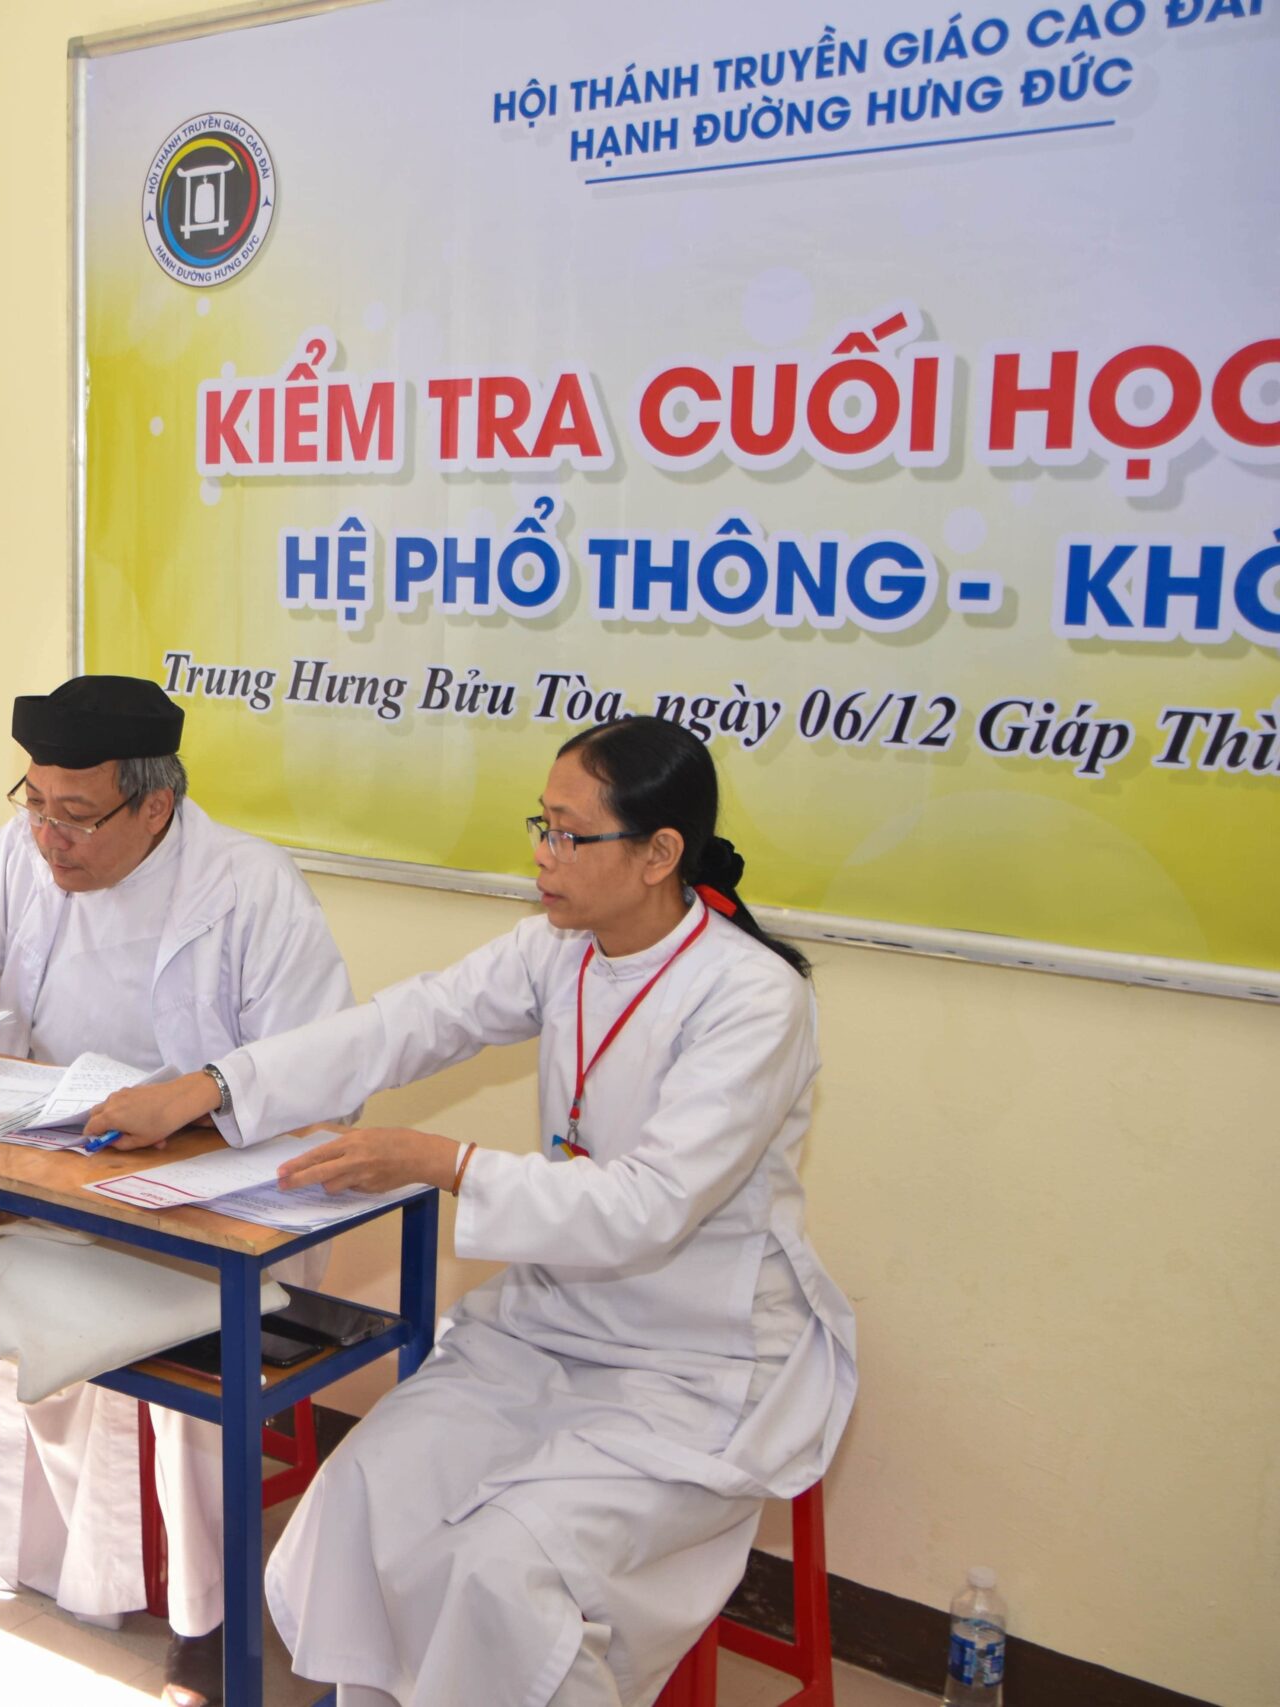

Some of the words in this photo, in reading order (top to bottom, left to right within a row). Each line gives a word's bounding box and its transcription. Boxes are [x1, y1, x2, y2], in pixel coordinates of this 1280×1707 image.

[493, 77, 558, 128] HỘI
[569, 62, 700, 113] THÁNH
[712, 24, 869, 93] TRUYỀN
[883, 11, 1010, 69] GIÁO
[1026, 0, 1146, 48] CAO
[570, 116, 679, 168] HẠNH
[692, 94, 852, 148] ĐƯỜNG
[866, 74, 1004, 127] HƯNG
[1019, 50, 1134, 108] ĐỨC
[182, 115, 221, 138] TRUYỀN
[246, 136, 263, 158] CAO
[206, 339, 395, 465] KIỂM
[428, 373, 602, 460] TRA
[639, 314, 939, 457] CUỐI
[286, 516, 367, 620] HỆ
[395, 495, 561, 607] PHỔ
[588, 517, 927, 620] THÔNG
[164, 653, 277, 710] Trung
[286, 660, 408, 720] Hưng
[419, 667, 515, 716] Bửu
[654, 684, 782, 747] ngày
[799, 689, 957, 747] 06/12
[979, 700, 1130, 775] Giáp
[1157, 710, 1280, 771] Thì
